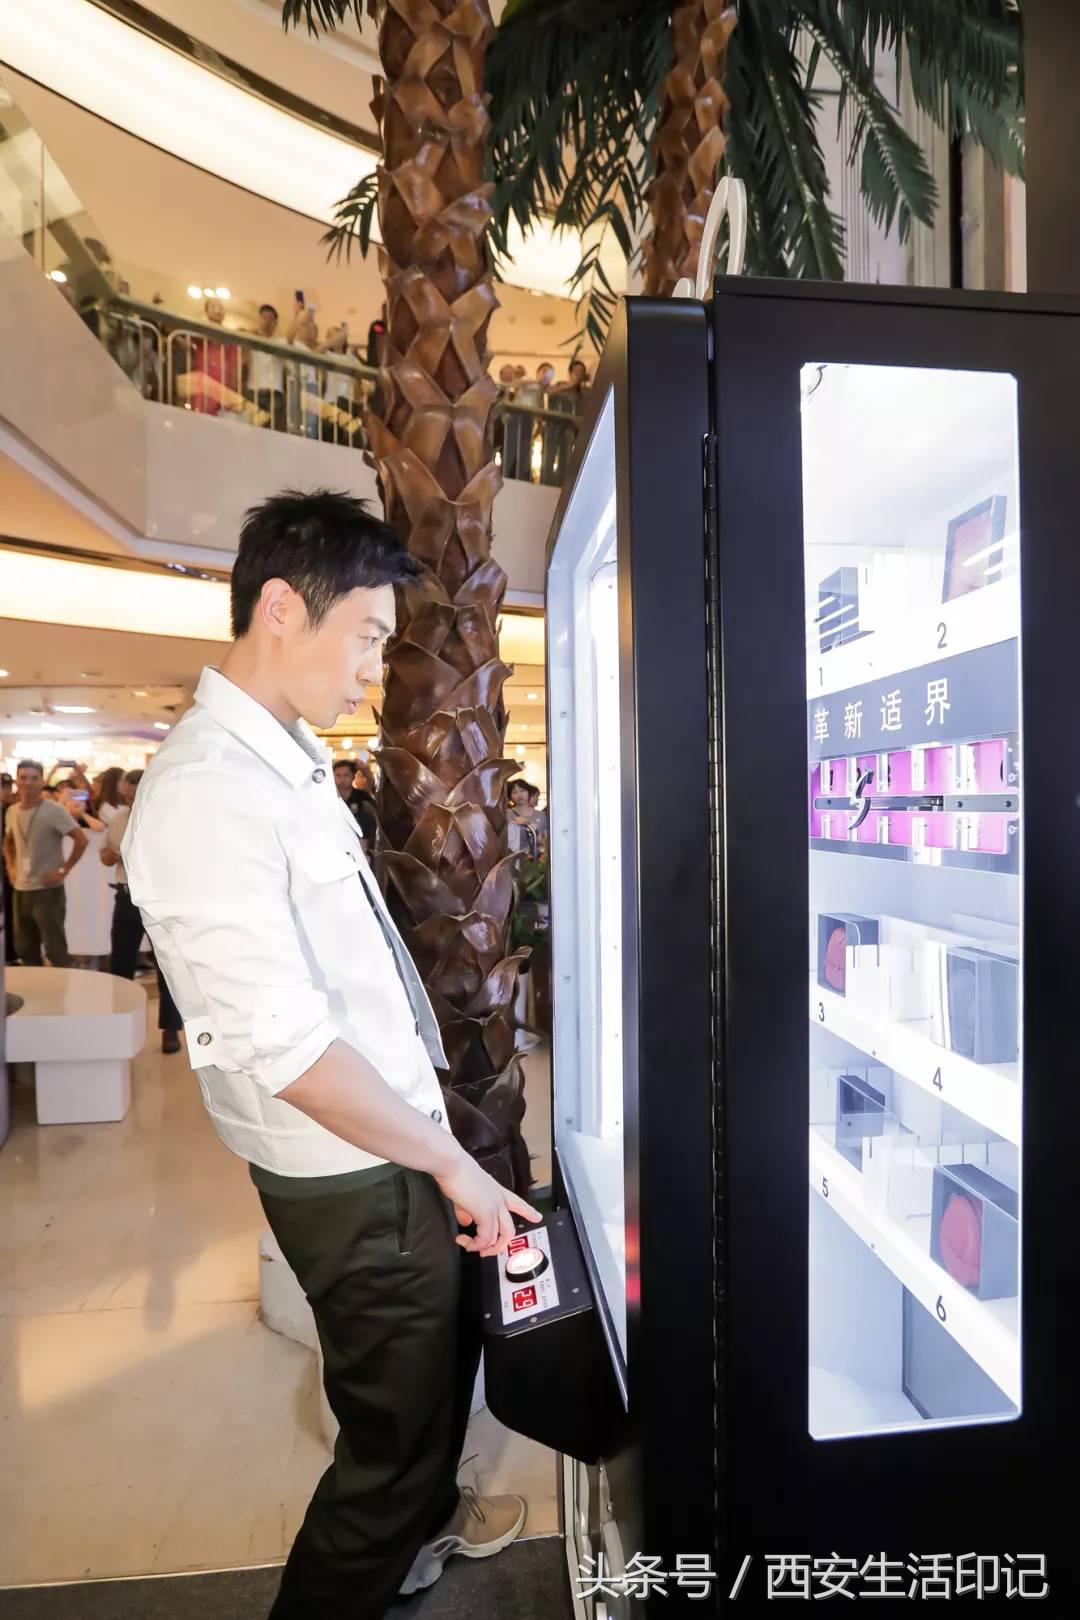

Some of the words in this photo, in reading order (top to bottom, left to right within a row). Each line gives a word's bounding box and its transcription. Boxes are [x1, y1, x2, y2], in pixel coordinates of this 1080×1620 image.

[936, 622, 947, 649] 2
[813, 677, 951, 744] 革新适界
[818, 1002, 826, 1022] 3
[932, 1066, 943, 1092] 4
[821, 1176, 830, 1198] 5
[935, 1295, 947, 1322] 6
